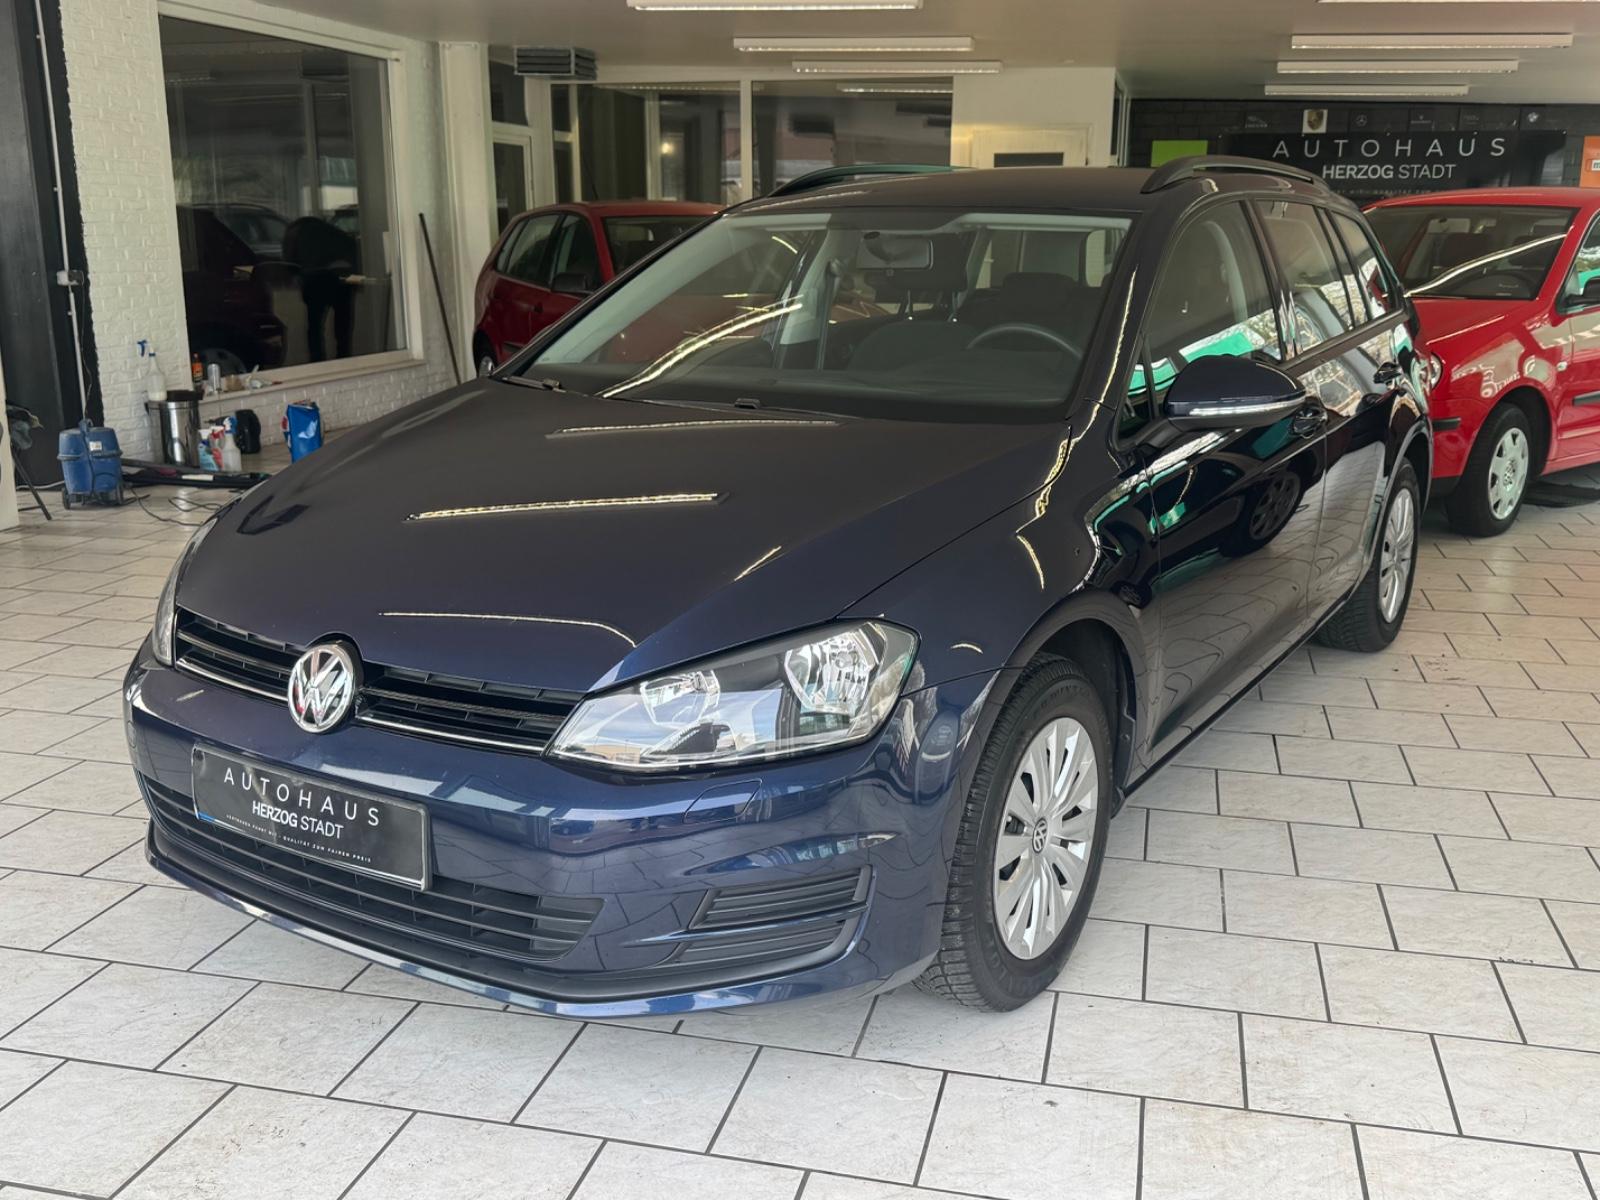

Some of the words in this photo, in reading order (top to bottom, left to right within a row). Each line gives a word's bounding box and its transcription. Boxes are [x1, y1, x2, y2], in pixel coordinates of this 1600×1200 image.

[1272, 138, 1505, 158] AUTOHAUS
[1322, 164, 1395, 179] HERZOG
[1398, 164, 1457, 179] STADT
[224, 767, 380, 827] AUTOHAUS
[252, 800, 298, 828] HERZOG
[300, 816, 344, 840] STADT
